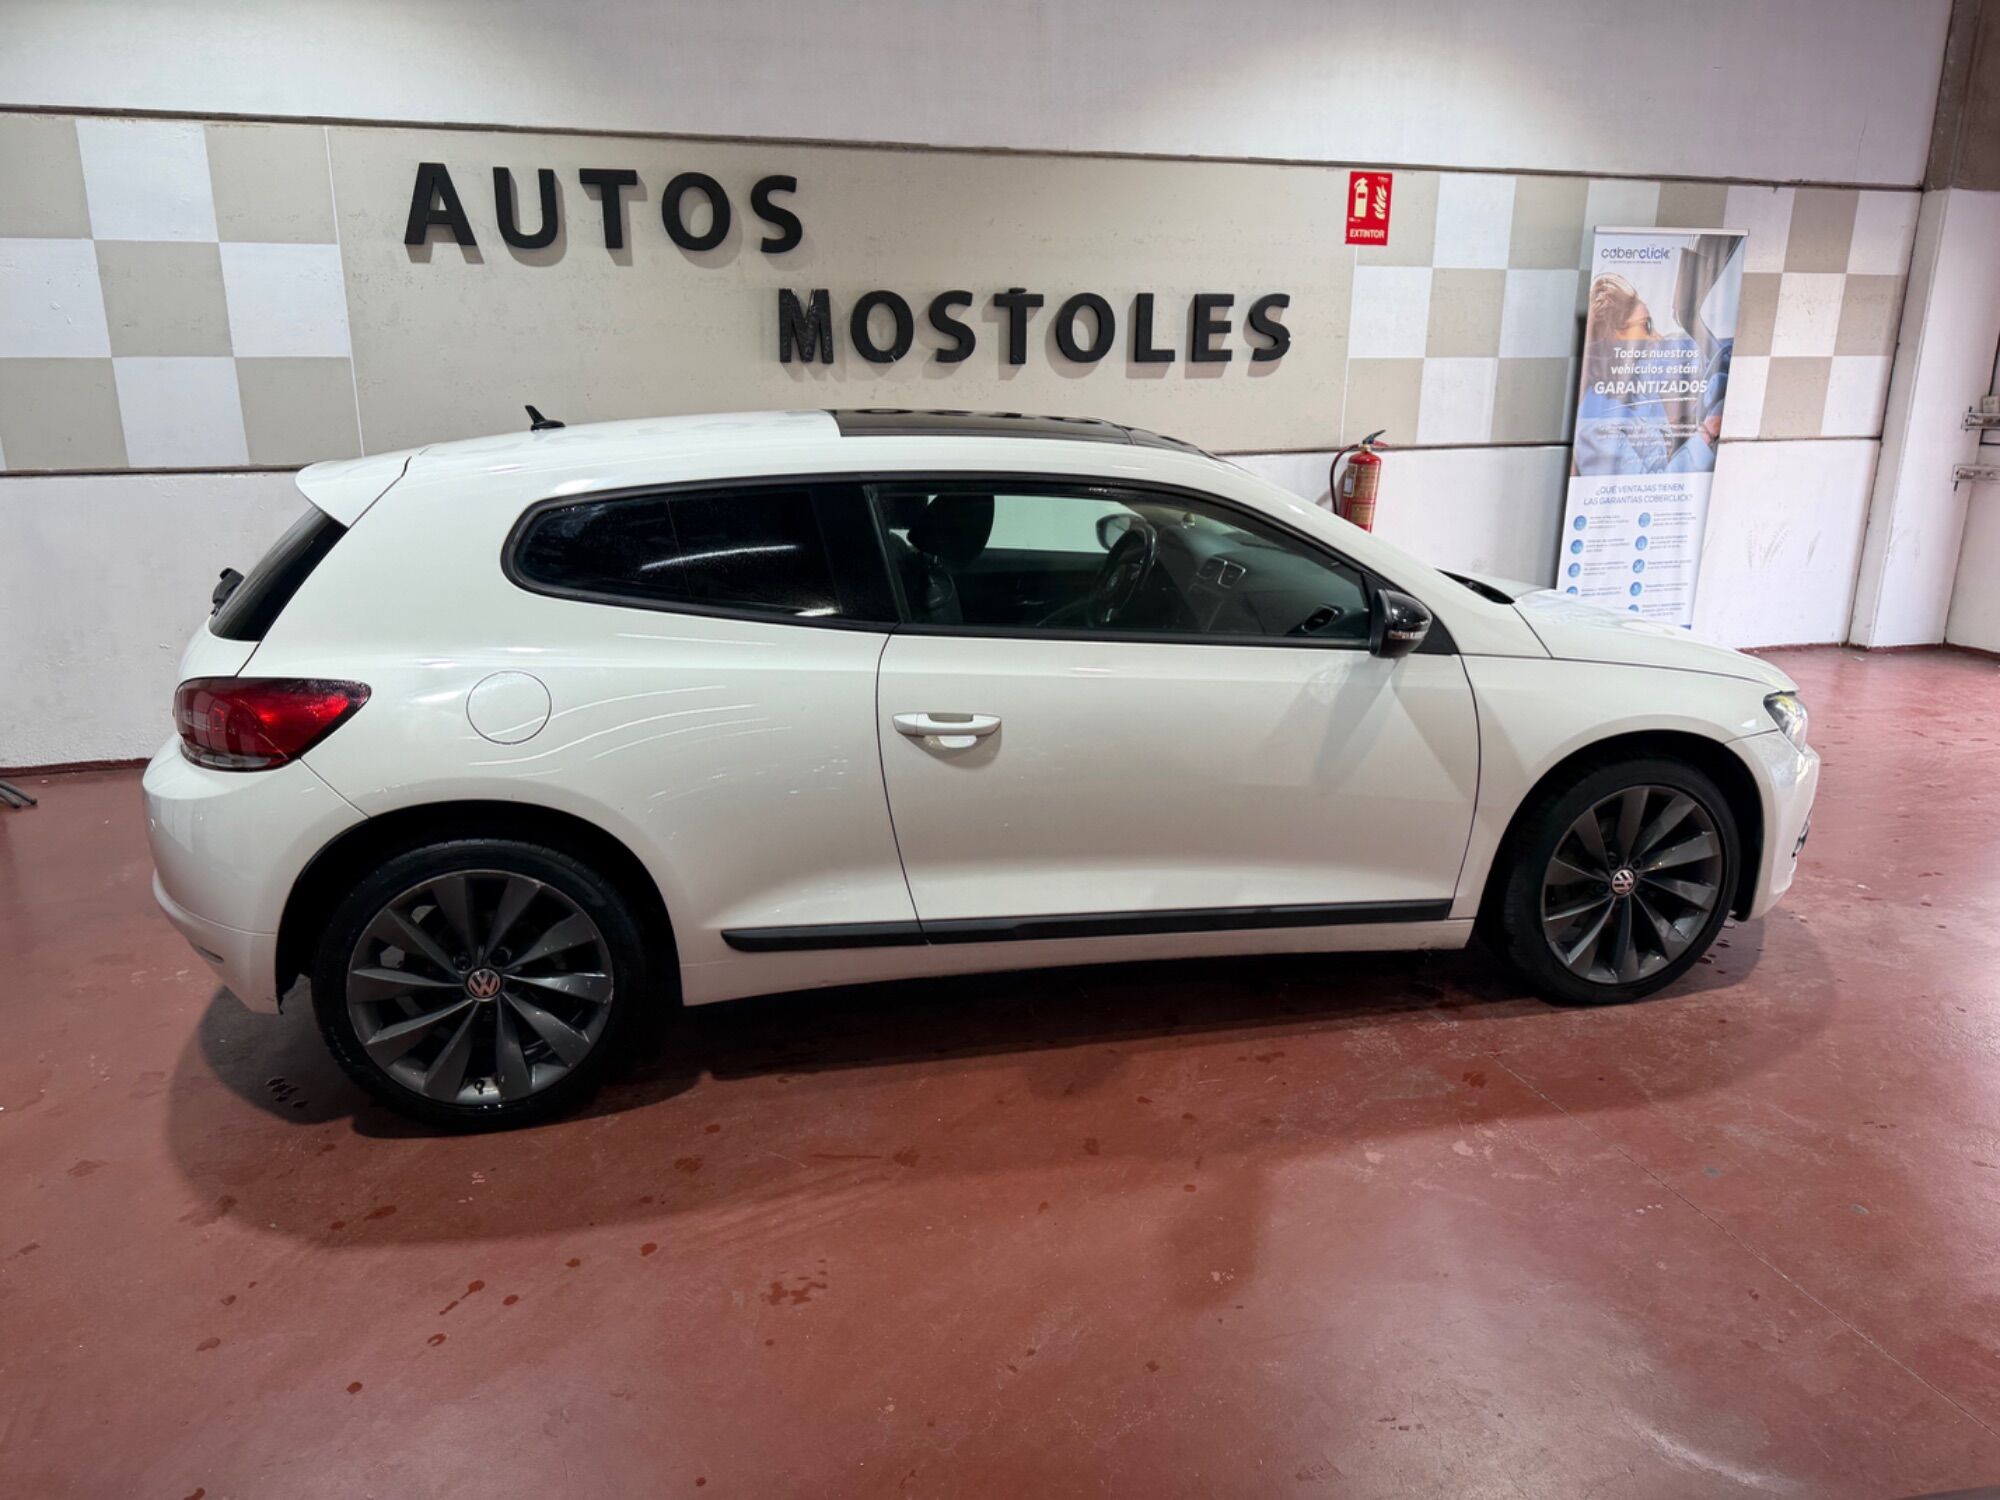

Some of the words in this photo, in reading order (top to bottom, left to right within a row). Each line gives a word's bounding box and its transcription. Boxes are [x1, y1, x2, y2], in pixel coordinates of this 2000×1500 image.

[404, 162, 803, 253] AUTOS
[1349, 228, 1385, 239] EXTINTOR
[778, 288, 1291, 365] MOSTOLES
[1614, 347, 1648, 359] Todos
[1649, 348, 1699, 359] nuestros
[1610, 363, 1664, 375] vehículos
[1665, 362, 1698, 375] están
[1594, 380, 1709, 395] GARANTIZADOS
[1583, 498, 1598, 506] LAS
